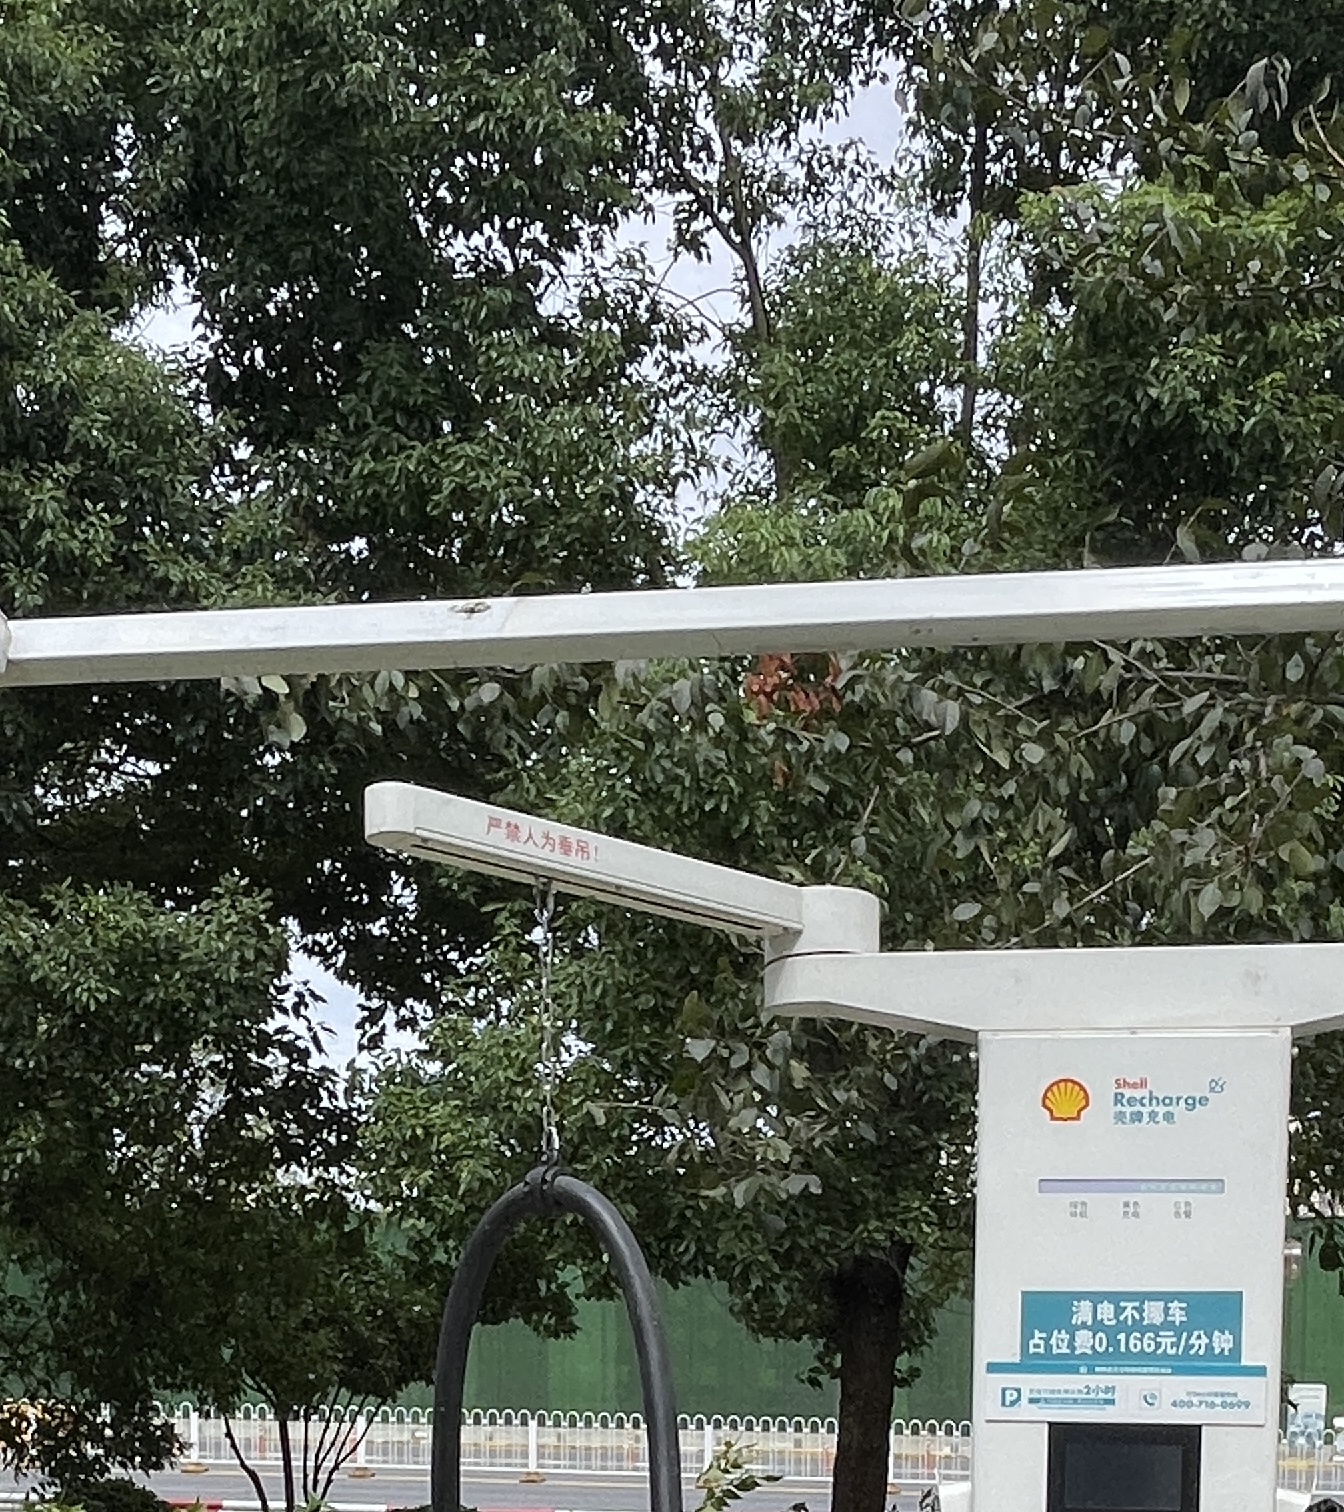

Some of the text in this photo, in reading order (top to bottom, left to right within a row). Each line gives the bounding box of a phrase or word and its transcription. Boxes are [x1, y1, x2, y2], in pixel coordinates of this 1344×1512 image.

[1114, 1077, 1148, 1090] Shell
[1113, 1091, 1210, 1111] Recharge
[1113, 1111, 1176, 1126] 壳牌充电
[1071, 1300, 1188, 1326] 满电不挪车
[1028, 1330, 1234, 1355] 占位费0.166元/分钟
